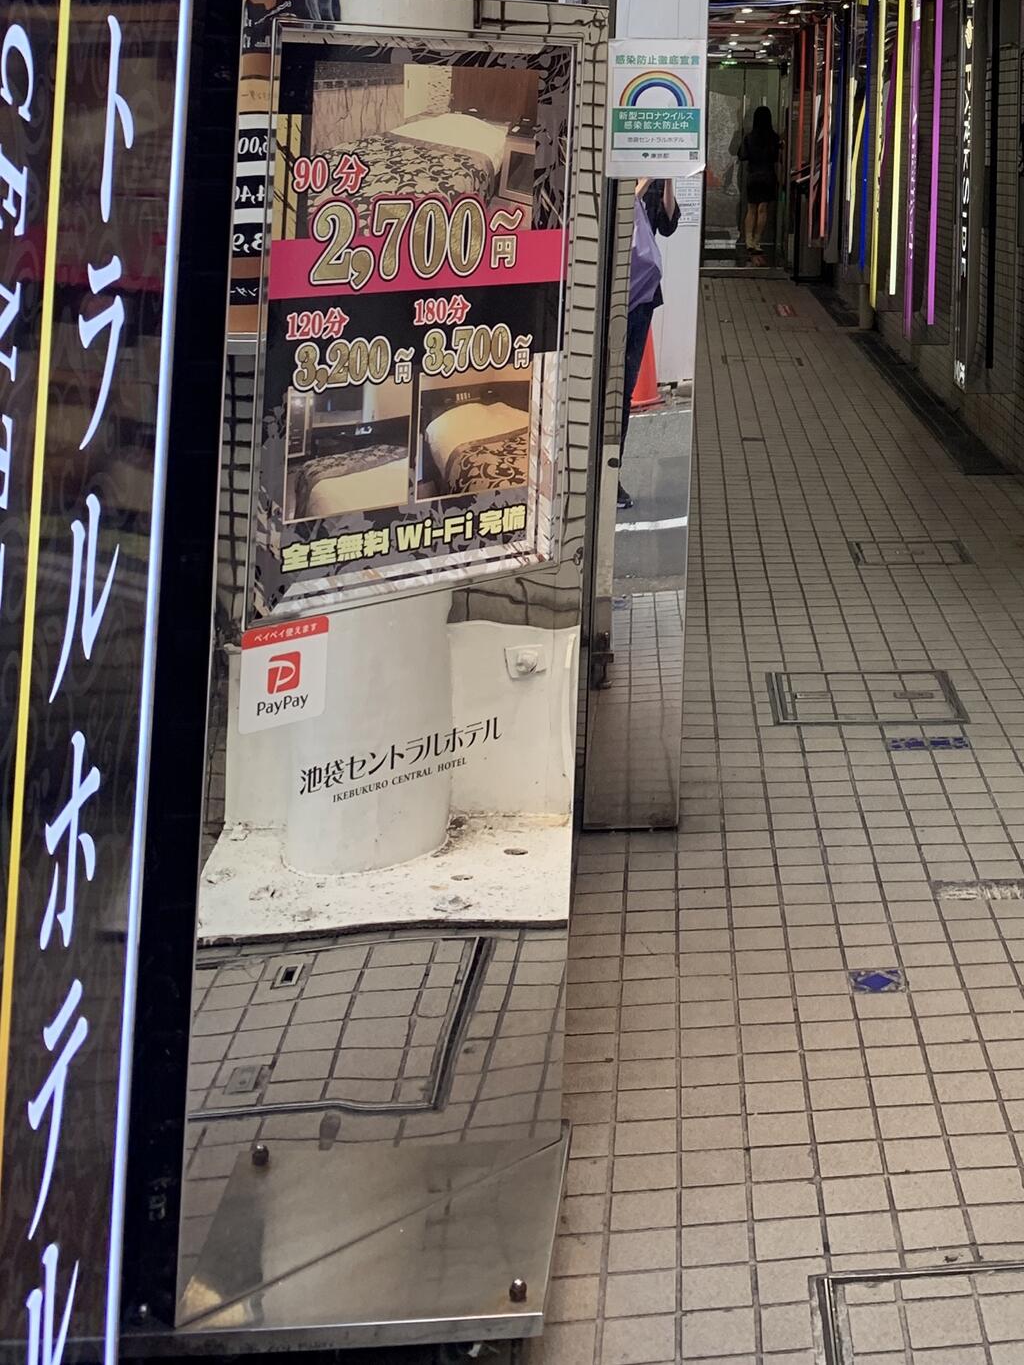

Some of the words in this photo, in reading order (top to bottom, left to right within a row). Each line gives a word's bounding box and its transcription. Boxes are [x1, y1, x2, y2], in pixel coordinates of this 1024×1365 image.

[292, 154, 370, 195] 90分
[286, 307, 349, 340] 120分
[413, 295, 471, 326] 180分
[256, 693, 309, 716] PayPay
[300, 716, 502, 796] 池袋セントラルホテル
[332, 779, 389, 803] IKEBUKURO
[391, 767, 433, 786] CENTRAL
[437, 757, 467, 773] HOTEL
